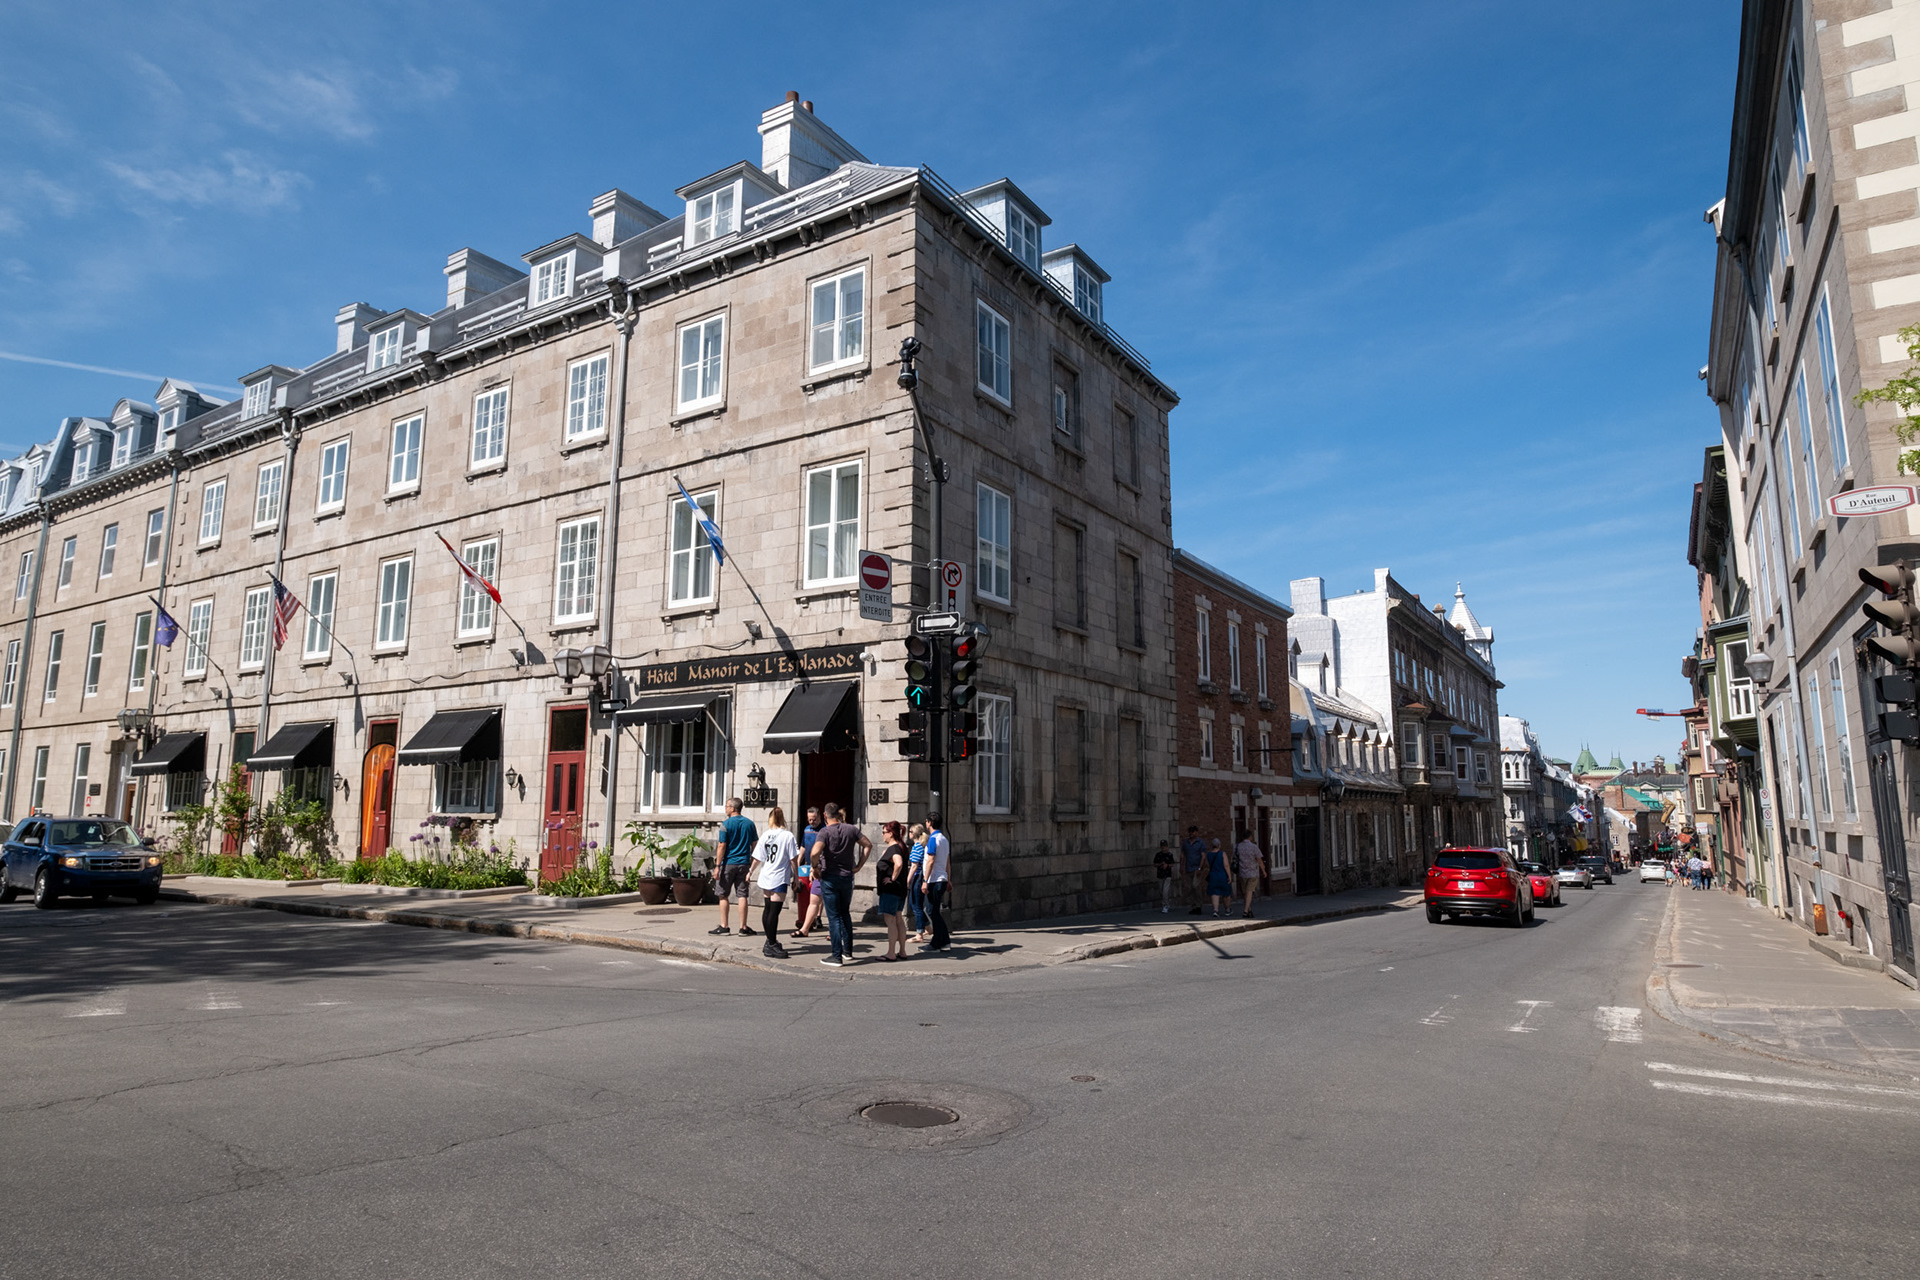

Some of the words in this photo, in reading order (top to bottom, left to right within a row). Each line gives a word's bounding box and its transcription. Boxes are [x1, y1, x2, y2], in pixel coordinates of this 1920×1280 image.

[1849, 495, 1895, 507] D'Auteuil
[861, 605, 891, 617] INTERDITE
[647, 666, 677, 685] Hôtel
[688, 663, 740, 682] Manoir
[744, 661, 760, 676] de
[764, 653, 855, 676] L'Esplanade
[871, 790, 884, 801] 83
